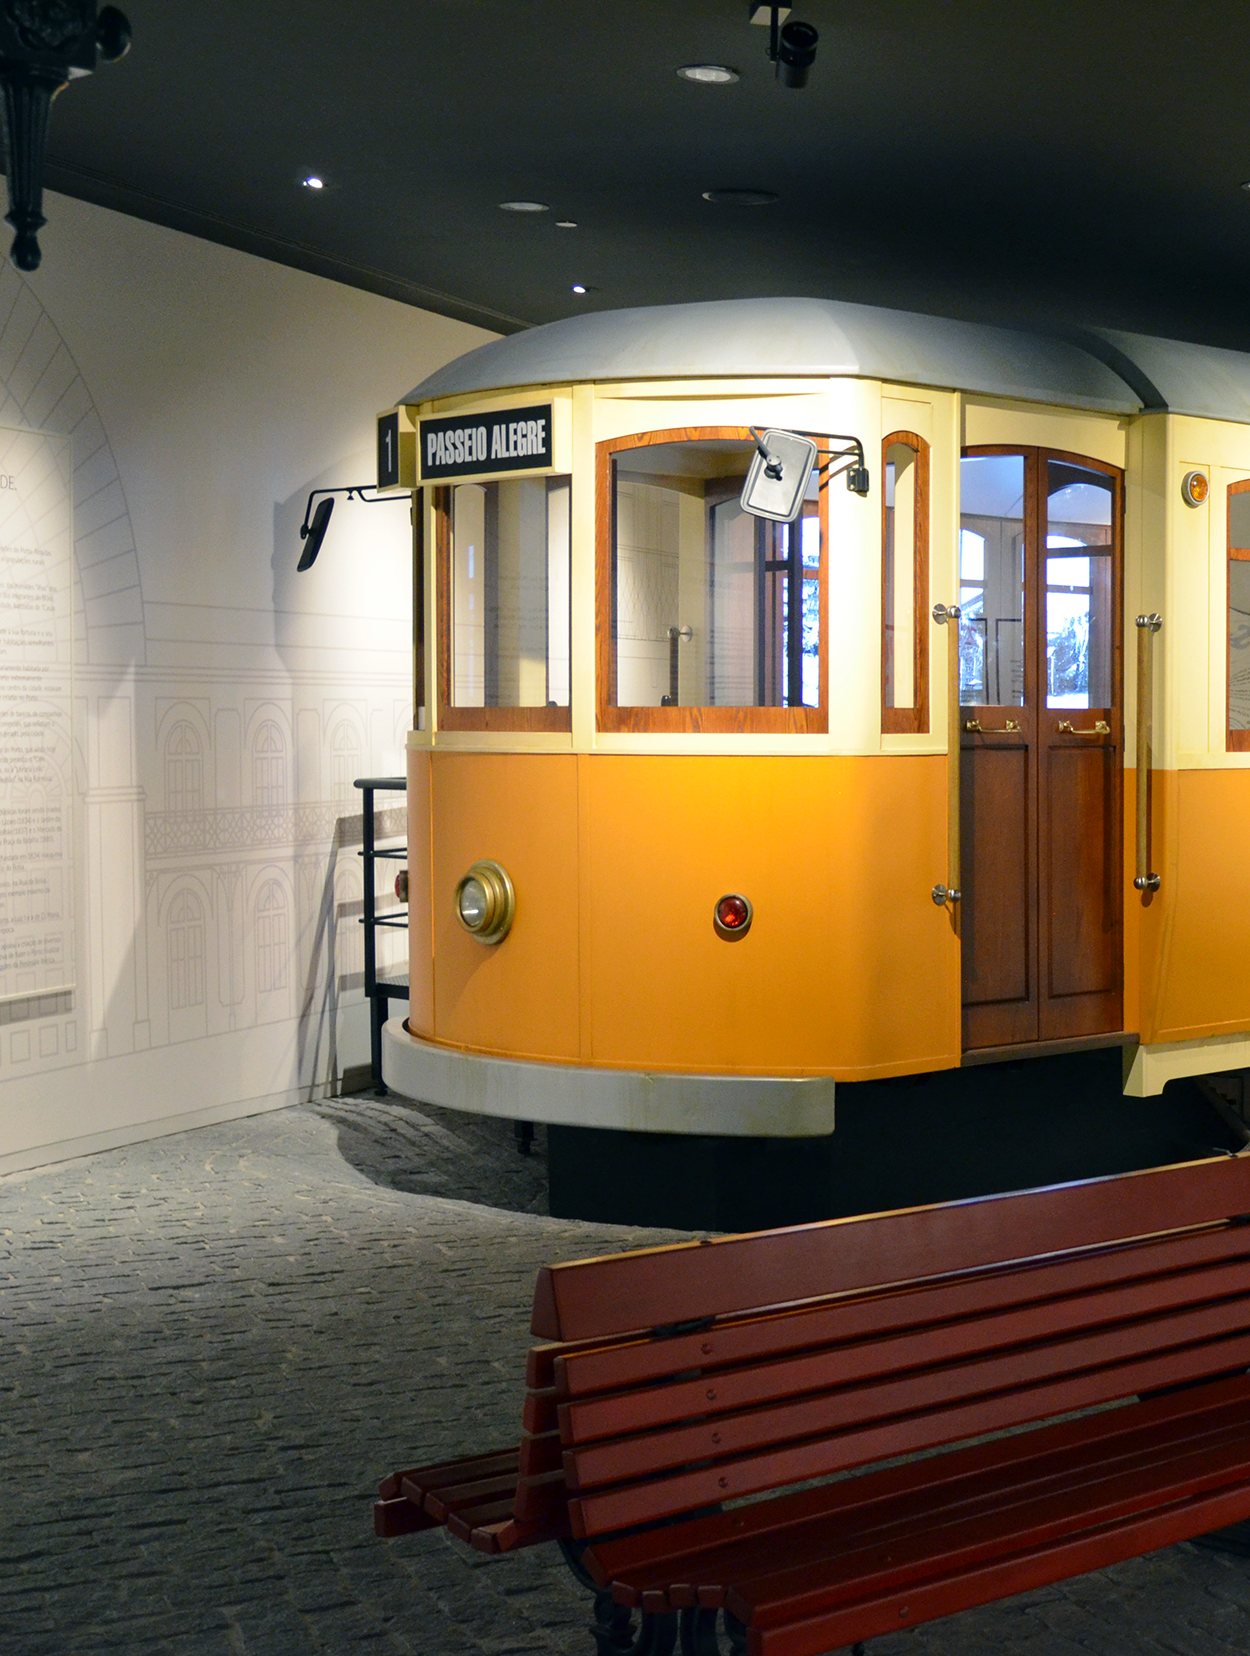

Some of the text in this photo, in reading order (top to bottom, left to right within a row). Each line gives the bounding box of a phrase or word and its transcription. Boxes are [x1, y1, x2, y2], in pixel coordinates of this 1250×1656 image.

[385, 429, 392, 473] 1
[427, 419, 547, 466] PASSEIO ALEGRE
